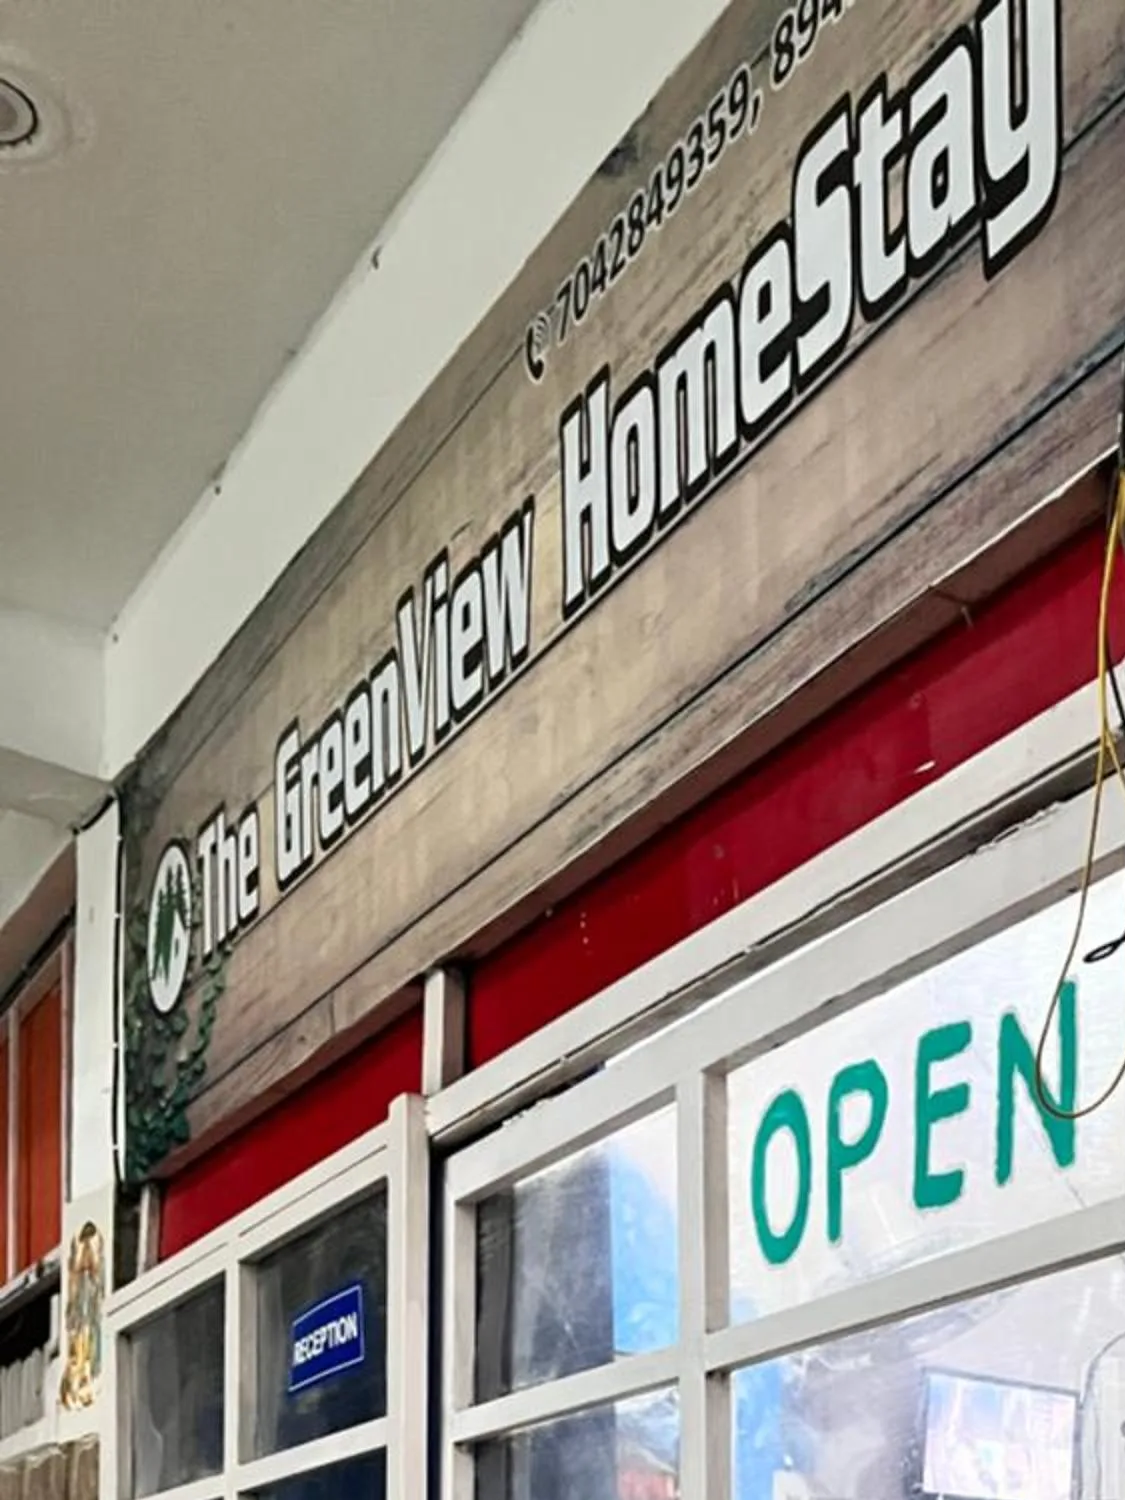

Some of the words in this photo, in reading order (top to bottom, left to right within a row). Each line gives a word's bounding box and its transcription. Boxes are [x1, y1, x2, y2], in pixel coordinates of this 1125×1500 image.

[555, 66, 761, 343] 7042849359,
[196, 803, 260, 960] The
[274, 494, 536, 892] GreenView
[559, 0, 1062, 620] HomeStay
[752, 979, 1077, 1265] OPEN
[292, 1311, 358, 1368] RECEPTION
